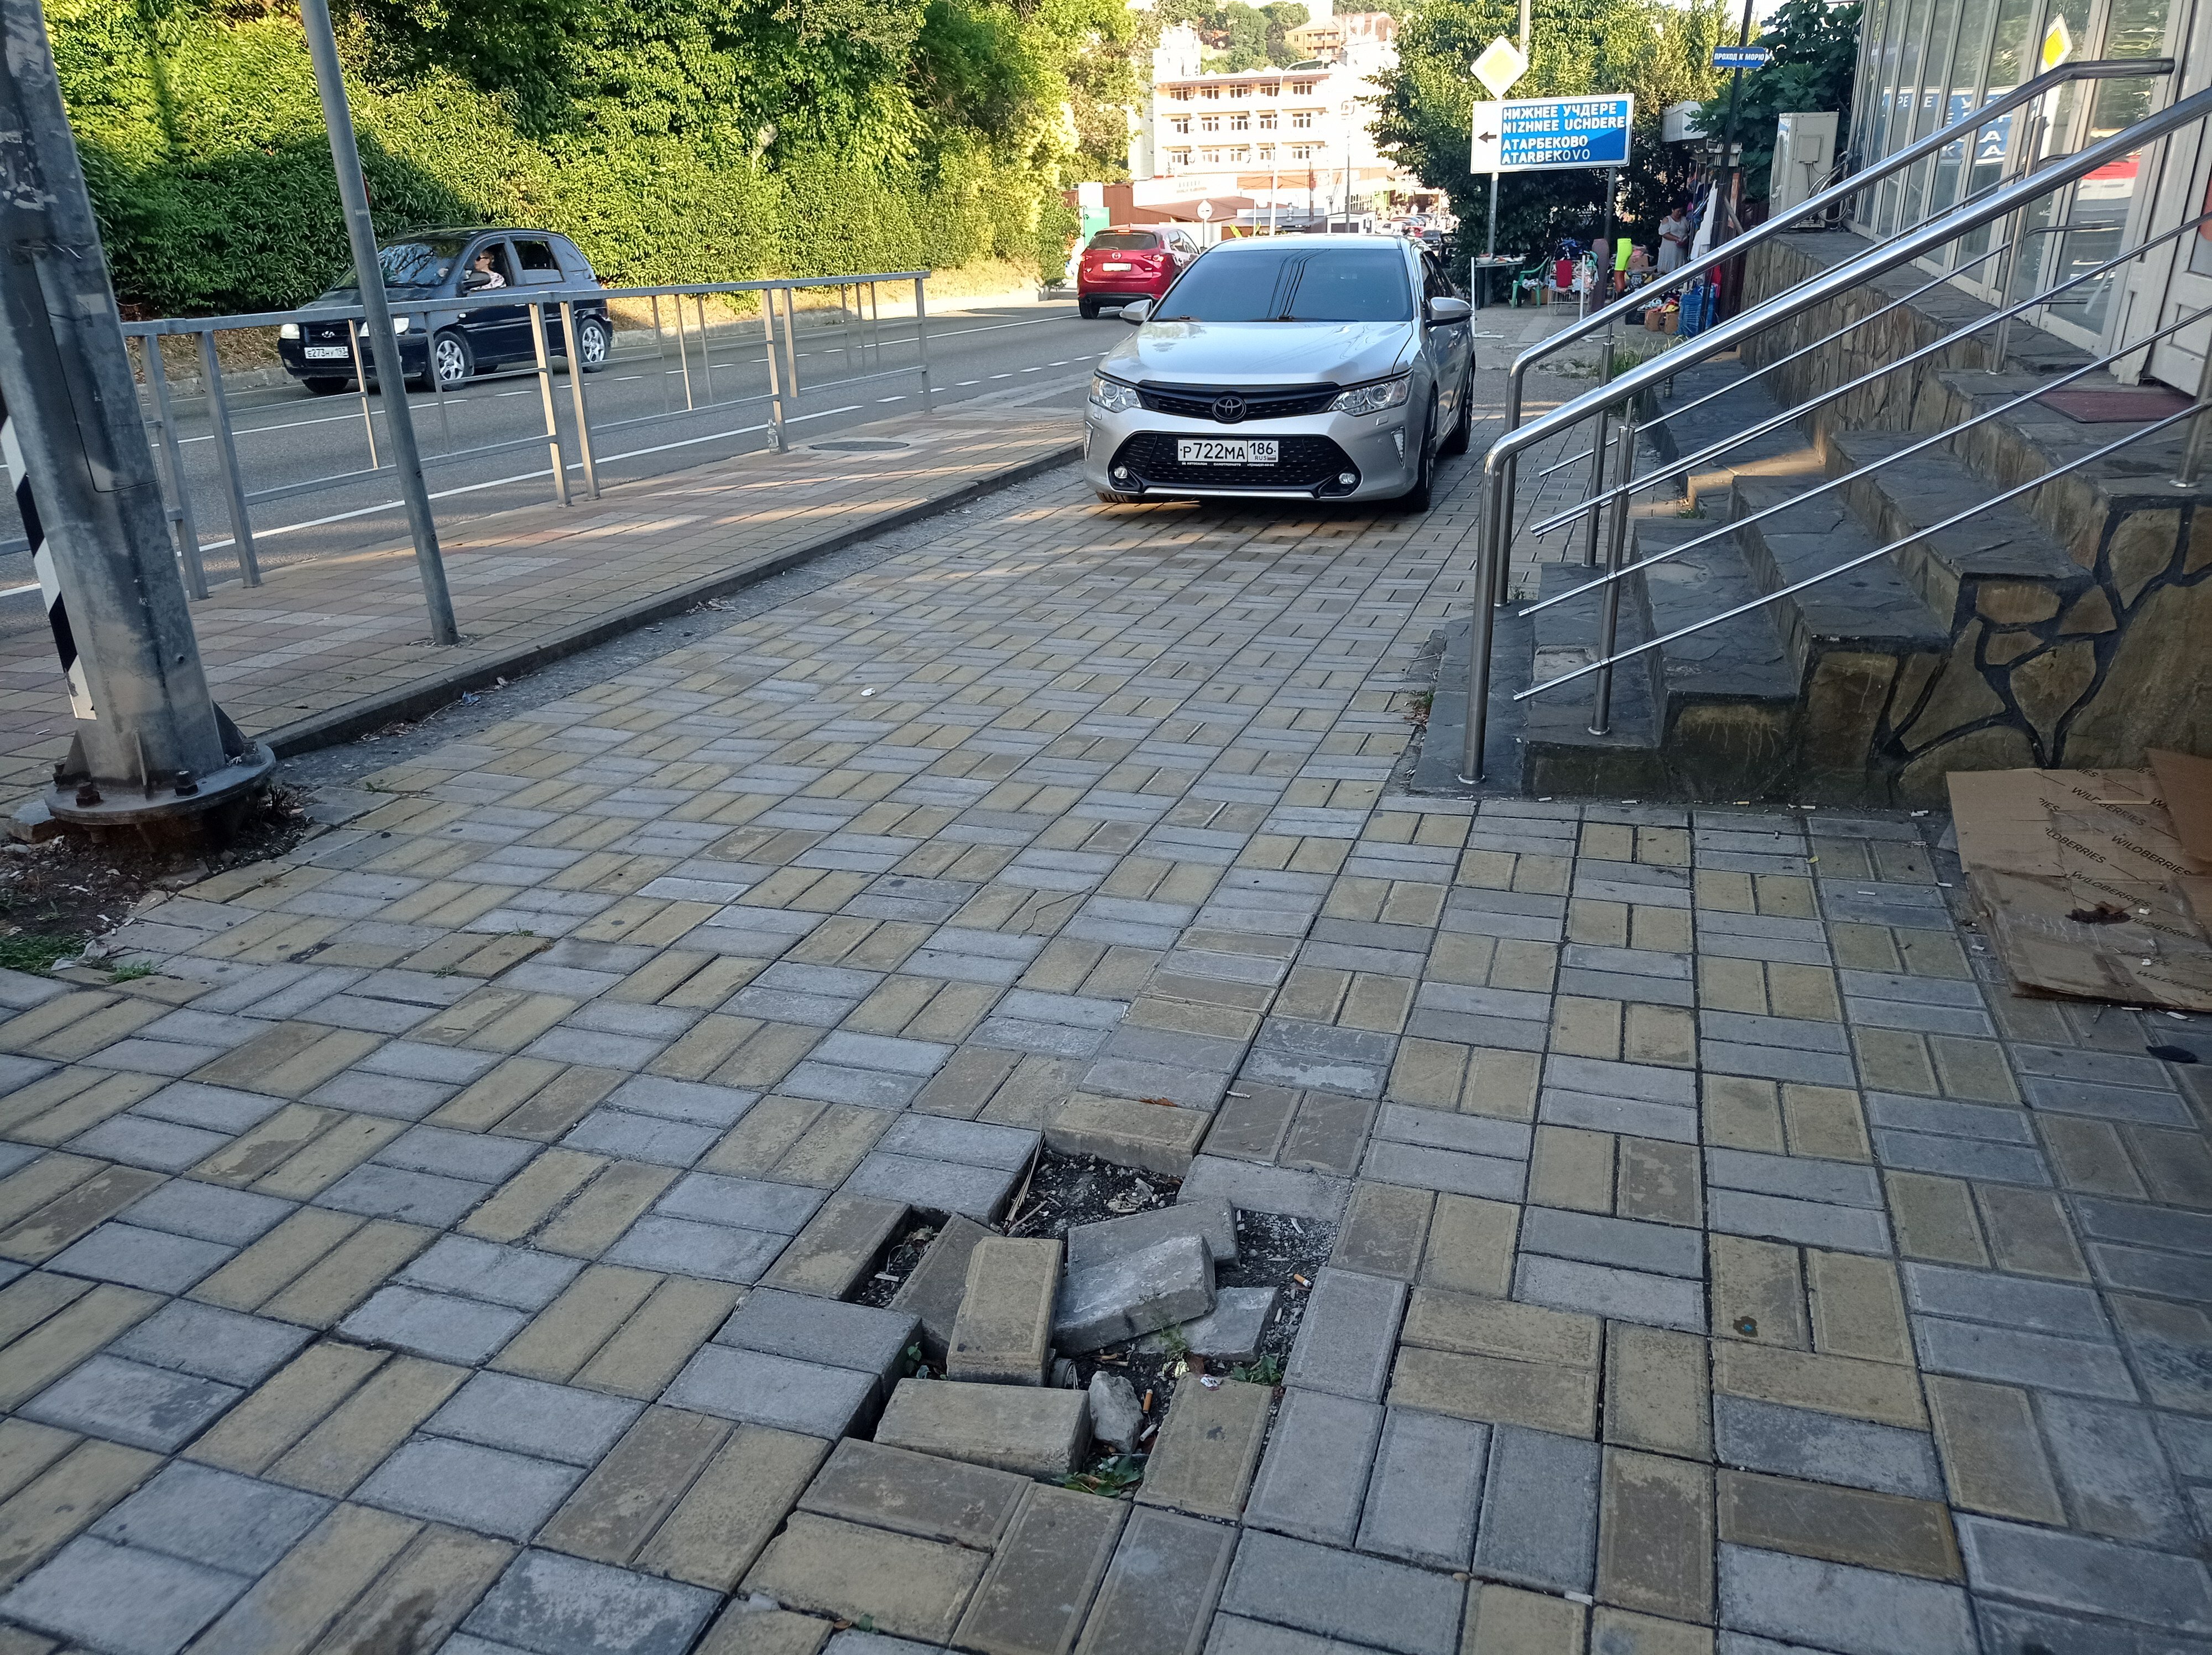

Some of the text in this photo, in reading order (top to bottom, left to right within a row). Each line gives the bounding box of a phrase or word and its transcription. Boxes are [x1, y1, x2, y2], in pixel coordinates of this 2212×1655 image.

[1714, 53, 1738, 61] ПРОХОД
[1503, 102, 1617, 121] НИЖНЕЕ УЧДЕРЕ
[1503, 116, 1625, 134] NIZHNEE UCHDERE
[1502, 134, 1589, 151] АТАРБЕКОВО
[1501, 148, 1590, 164] ATARBEKOVO
[1249, 442, 1274, 455] 186
[2045, 827, 2106, 863] ILDBERRIES
[2072, 871, 2153, 907] WILDBERRIES
